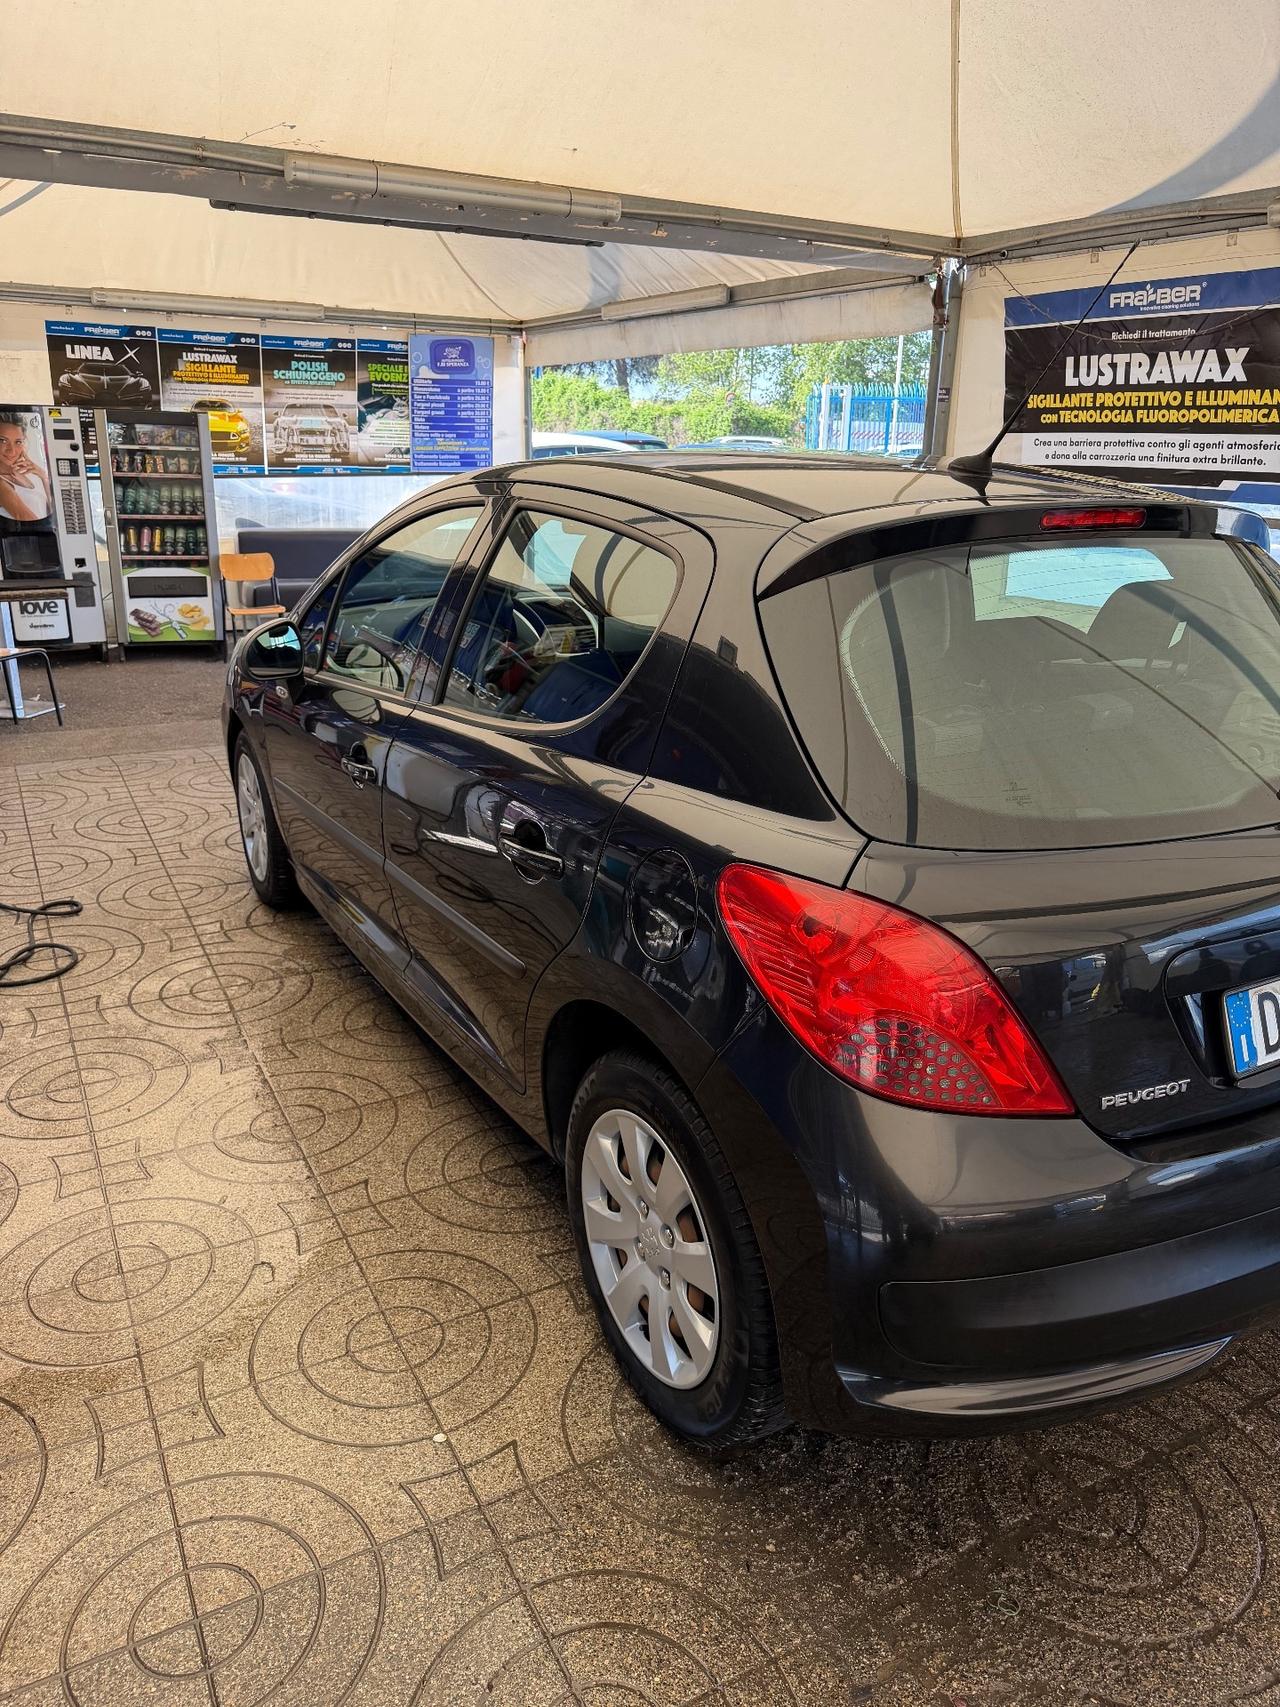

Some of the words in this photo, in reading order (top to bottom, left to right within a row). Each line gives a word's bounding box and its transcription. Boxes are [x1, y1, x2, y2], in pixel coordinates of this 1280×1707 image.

[1112, 330, 1140, 340] Richiedi
[1142, 330, 1147, 338] il
[1148, 328, 1196, 338] trattamento
[65, 344, 115, 361] LINEA
[114, 344, 141, 366] X
[182, 352, 238, 364] LUSTRAWAX
[185, 363, 236, 374] SIGILLANTE
[291, 361, 328, 372] POLISH
[368, 363, 404, 372] SPECIALE
[1065, 347, 1250, 387] LUSTRAWAX
[273, 370, 346, 382] SCHIUMOGENO
[370, 372, 408, 382] EVOENZ
[1027, 392, 1094, 408] SIGILLANTE
[1096, 391, 1182, 406] PROTETTIVO
[1184, 390, 1194, 406] E
[1059, 410, 1134, 423] TECNOLOGIA
[1136, 408, 1280, 423] FLUOROPOLIMERICA
[1034, 438, 1051, 446] Crea
[1070, 438, 1101, 447] barriera
[1104, 439, 1145, 449] protettiva
[1147, 440, 1176, 448] contro
[1178, 440, 1190, 451] gli
[1193, 440, 1224, 452] agenti
[1052, 451, 1070, 460] dona
[1072, 451, 1087, 460] alla
[1089, 453, 1136, 461] carrozzeria
[1157, 452, 1190, 463] finitura
[1193, 455, 1218, 464] extra
[1220, 454, 1266, 466] brillante.
[20, 600, 58, 614] love
[1240, 1034, 1250, 1062] I
[1101, 1079, 1190, 1110] PEUGEOT
